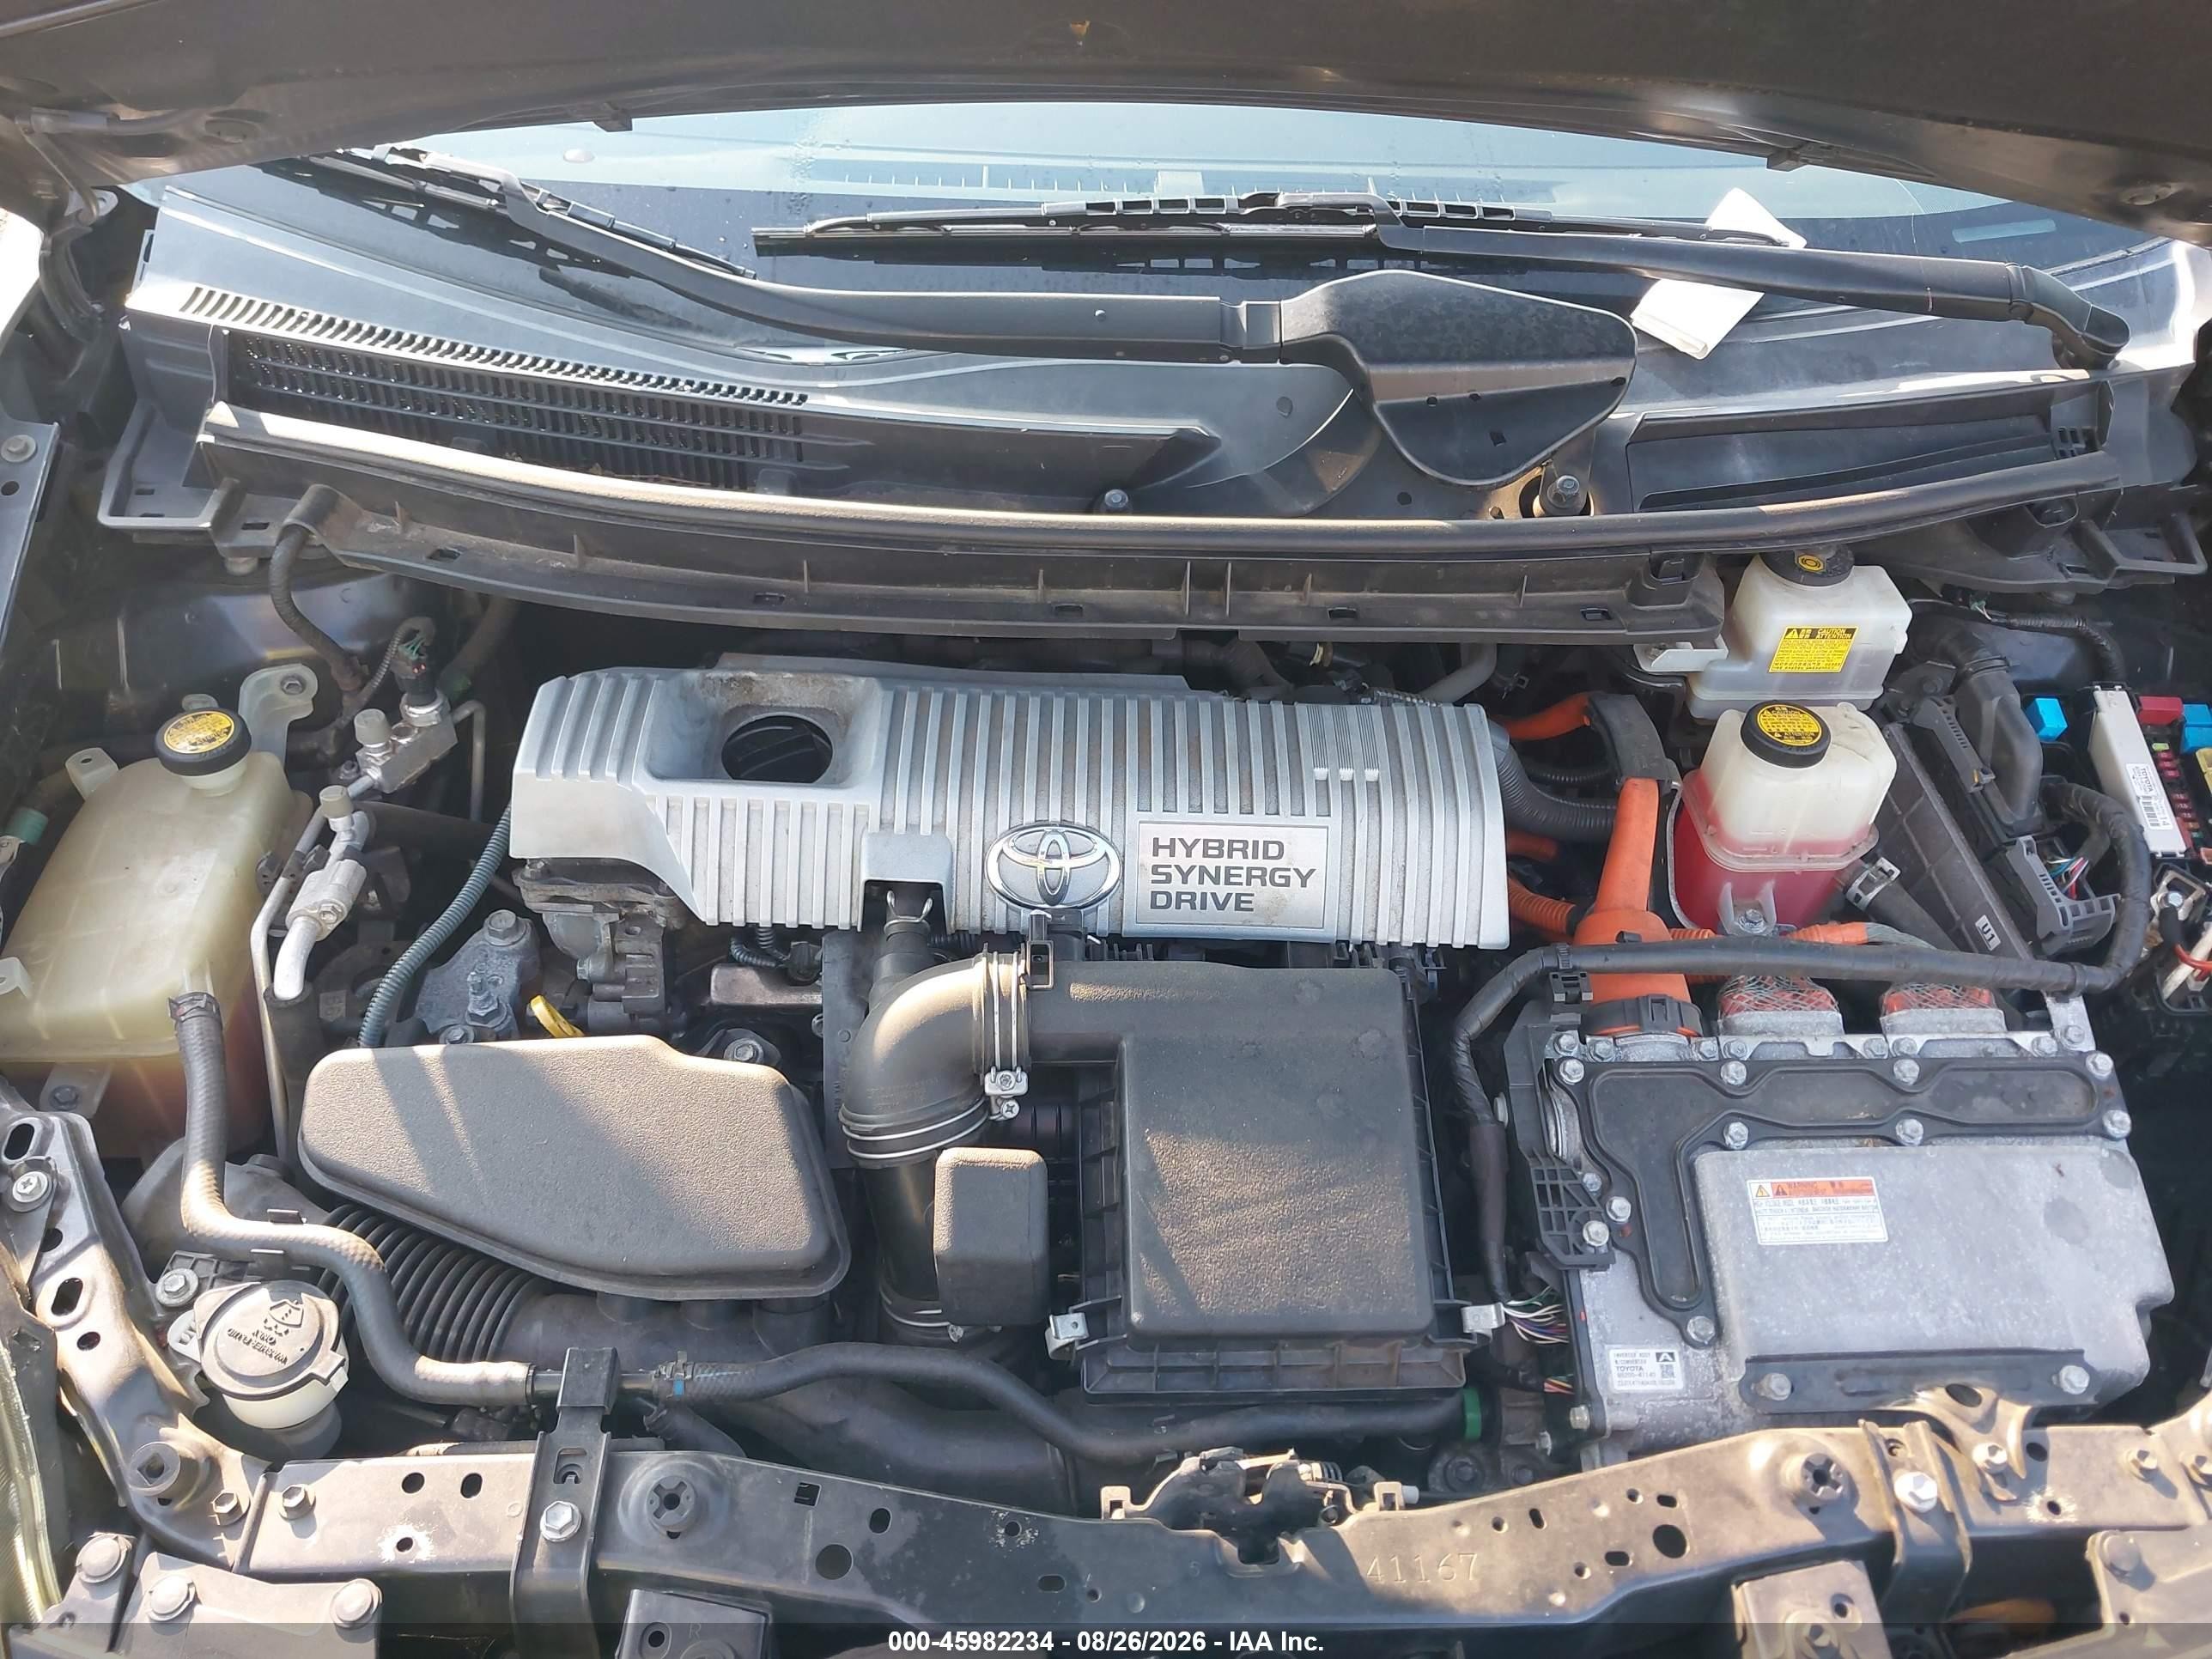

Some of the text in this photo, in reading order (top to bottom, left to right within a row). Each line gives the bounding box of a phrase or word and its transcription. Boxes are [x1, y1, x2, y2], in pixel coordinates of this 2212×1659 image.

[2141, 768, 2154, 793] TOYOTA
[1152, 836, 1285, 860] HYBRID
[1151, 864, 1317, 888] SYNERGY
[1150, 890, 1255, 912] DRIVE
[1981, 922, 1996, 942] U1
[1366, 1552, 1479, 1584] 41167
